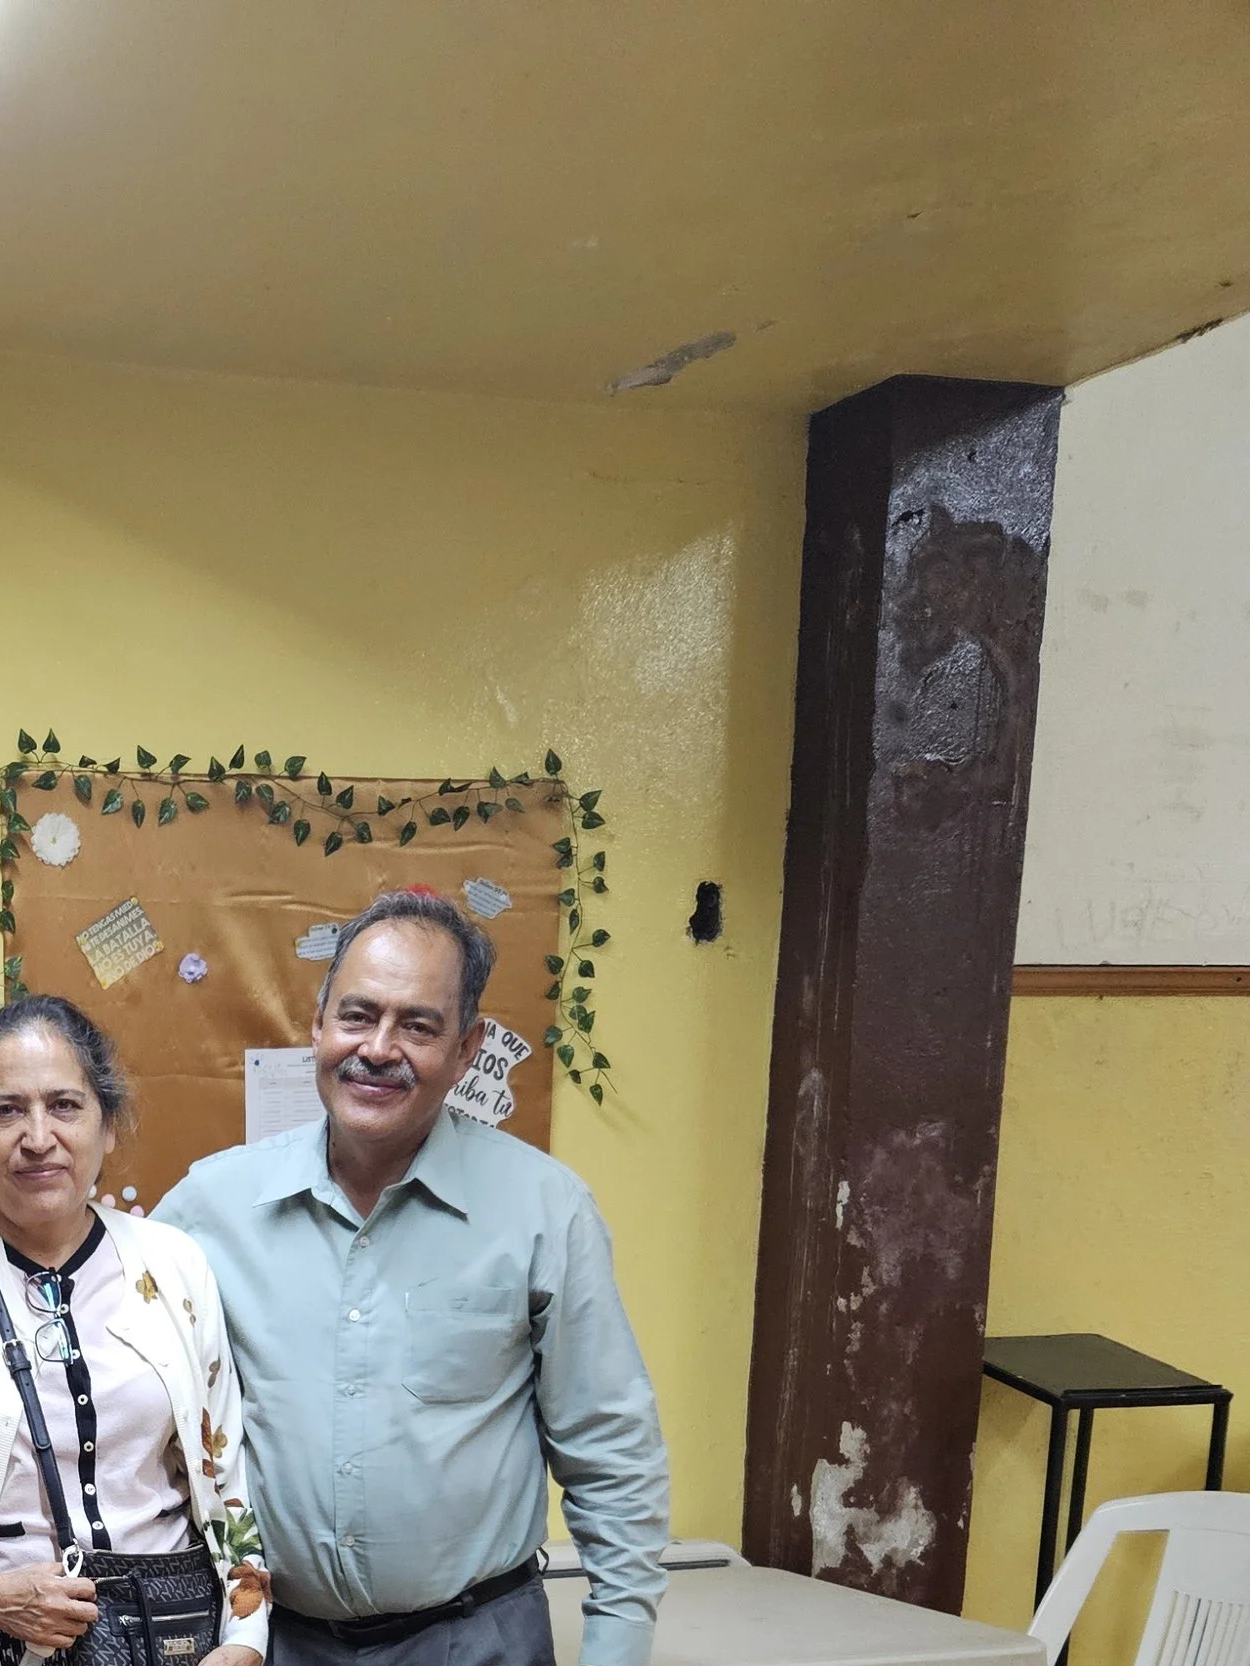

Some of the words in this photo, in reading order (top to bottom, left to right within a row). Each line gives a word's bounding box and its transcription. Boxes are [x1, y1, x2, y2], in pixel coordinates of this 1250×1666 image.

[114, 900, 134, 918] MIED
[102, 917, 151, 955] BATALLA
[501, 1031, 530, 1061] QUE
[470, 1048, 509, 1081] IOS
[453, 1075, 490, 1107] riba
